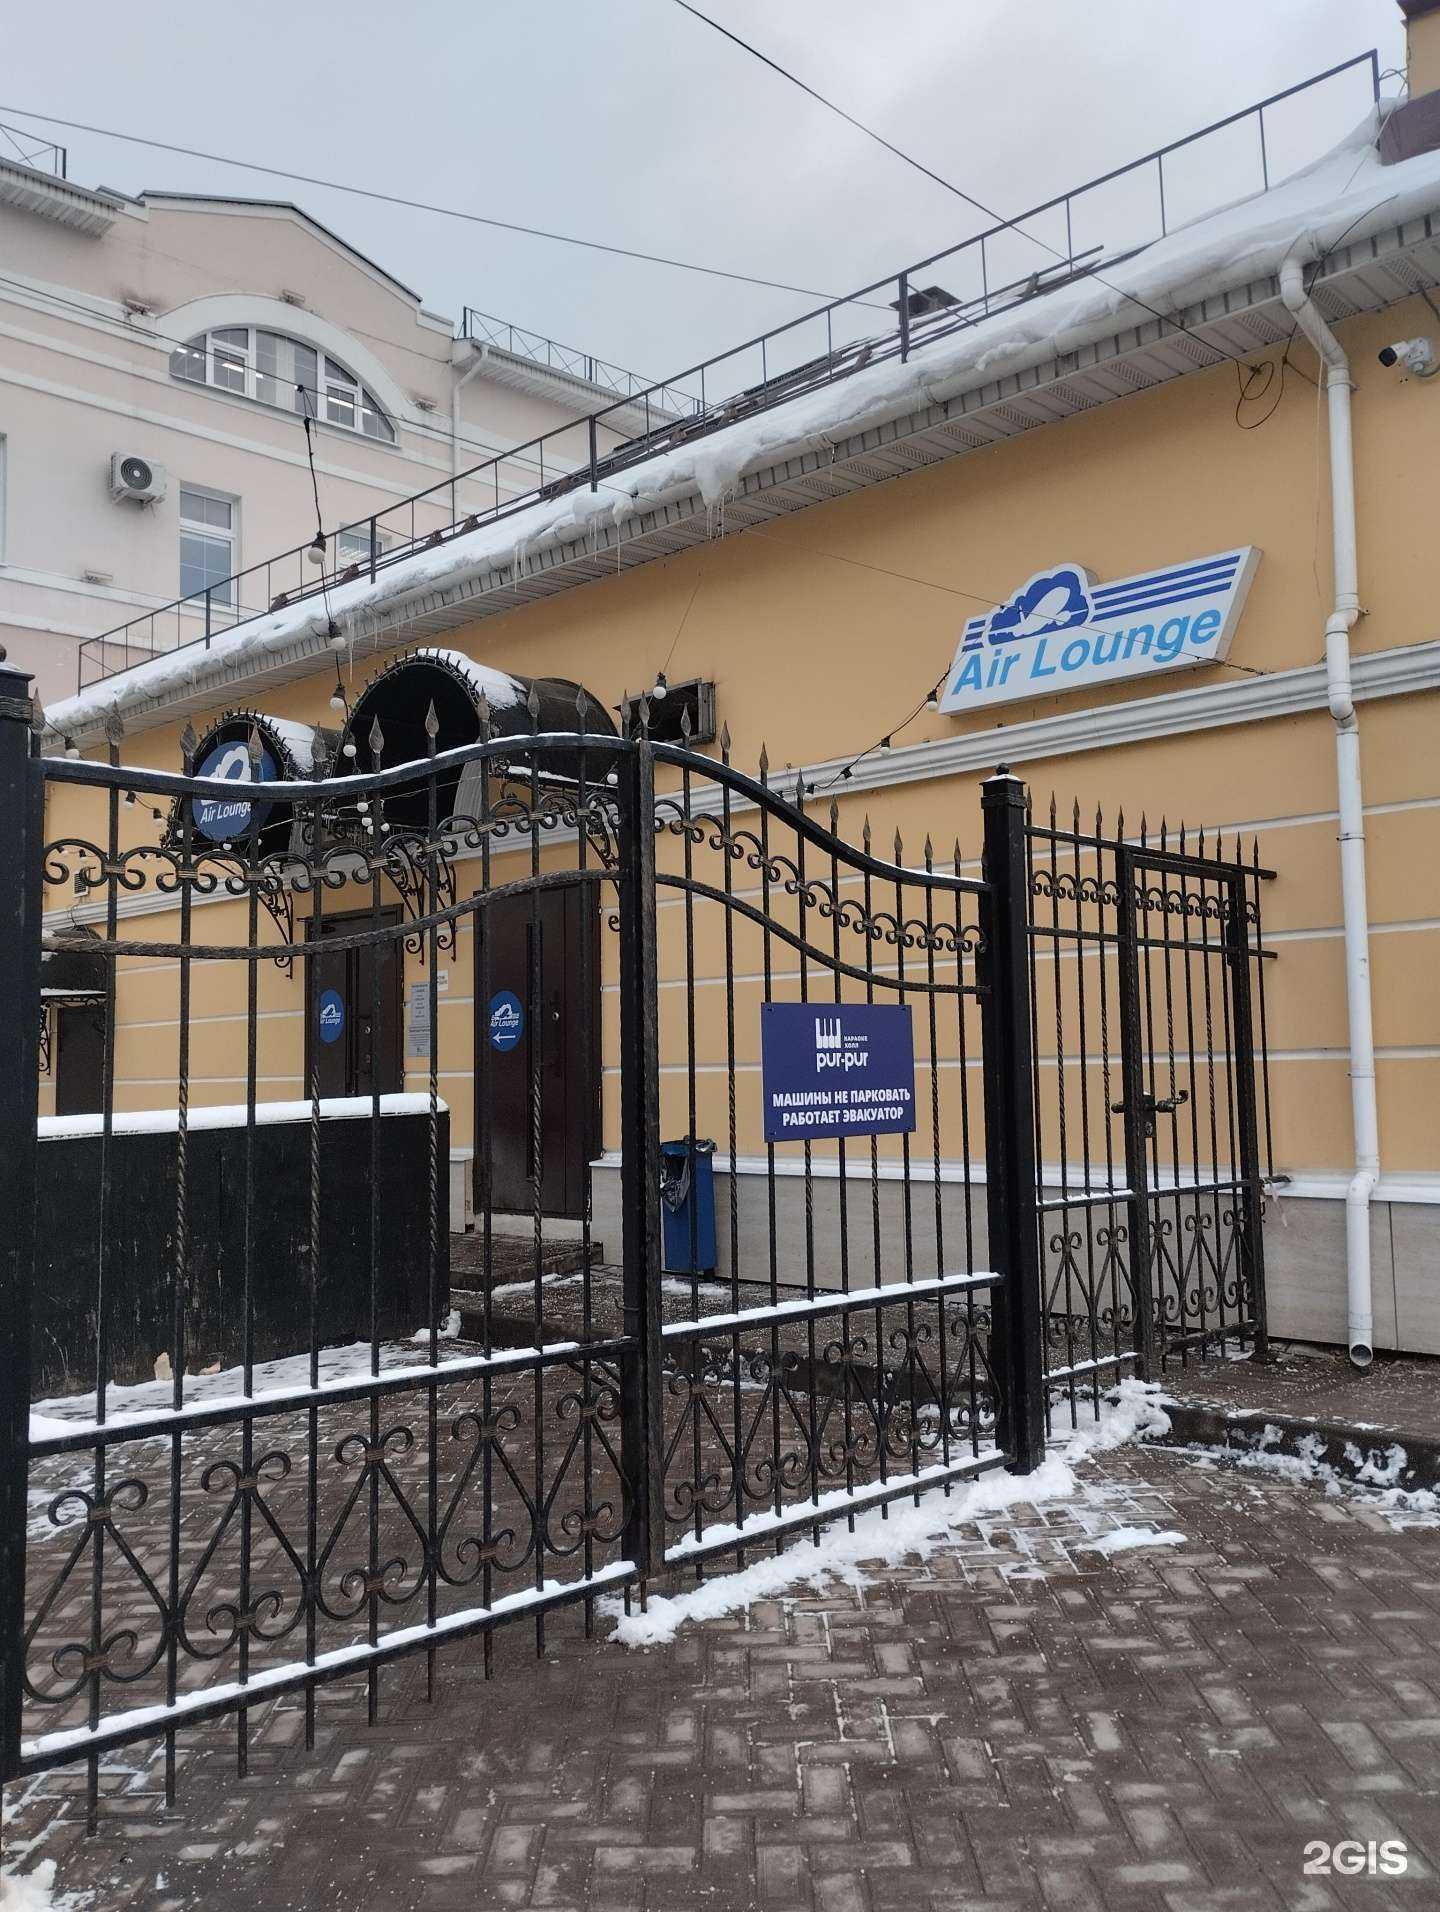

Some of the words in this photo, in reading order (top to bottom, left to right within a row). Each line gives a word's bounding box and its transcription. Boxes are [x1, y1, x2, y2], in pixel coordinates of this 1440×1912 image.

[952, 648, 1020, 695] Air
[1030, 609, 1222, 679] Lounge
[200, 806, 216, 823] Air
[499, 1018, 519, 1028] Lounge
[816, 1052, 869, 1072] pur-pur
[772, 1092, 832, 1107] МАШИНЫ
[834, 1090, 848, 1104] НЕ
[850, 1087, 911, 1103] ПАРКОВАТЬ
[782, 1110, 840, 1126] РАБОТАЕТ
[843, 1106, 904, 1123] ЭВАКУАТОР
